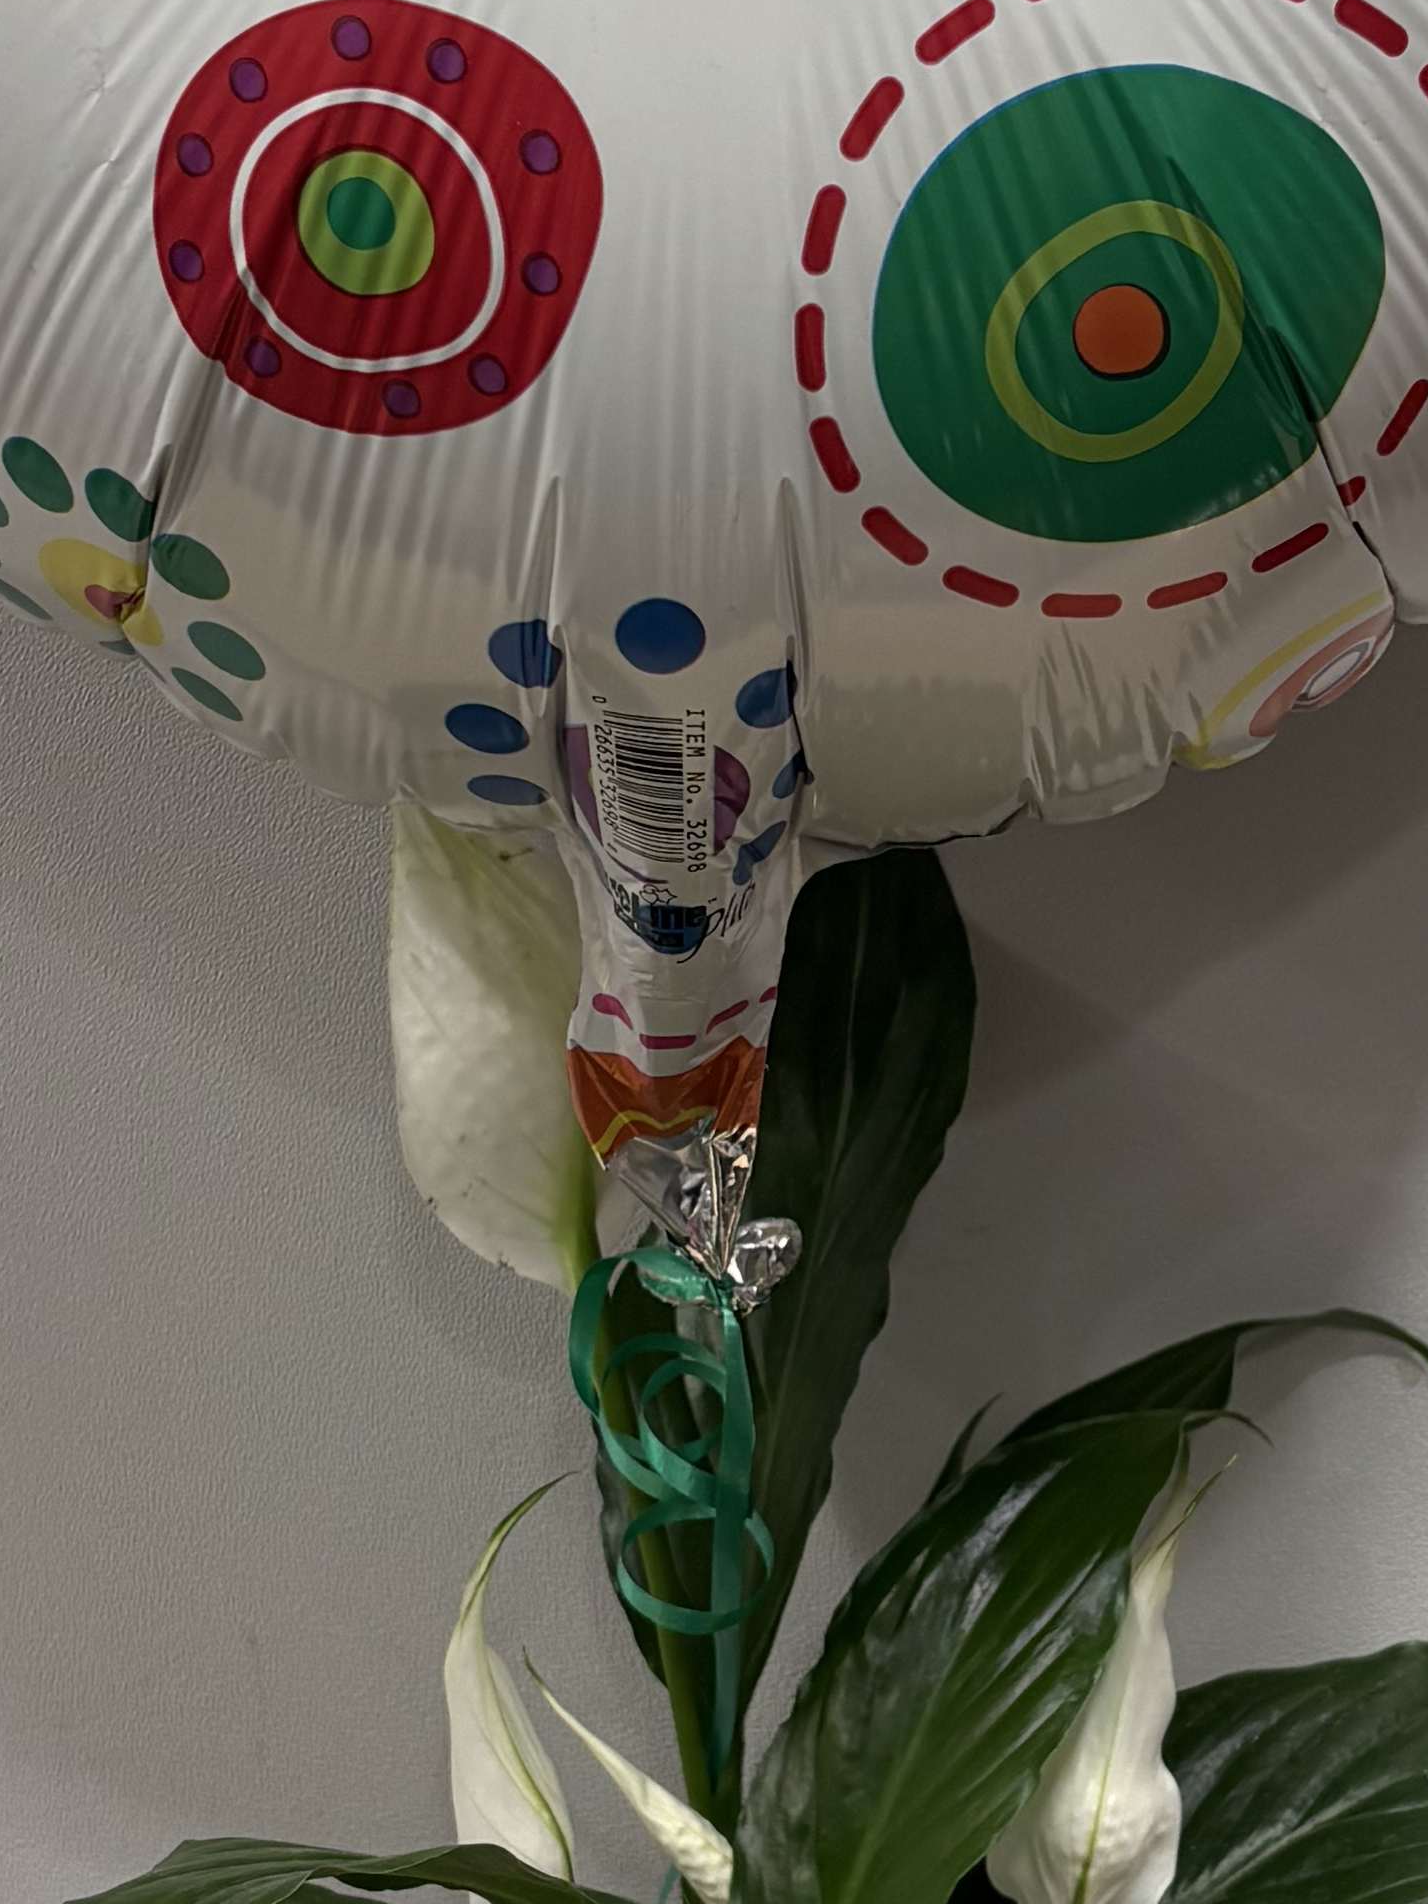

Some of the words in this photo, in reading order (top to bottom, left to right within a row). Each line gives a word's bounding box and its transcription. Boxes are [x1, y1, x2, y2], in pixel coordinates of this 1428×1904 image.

[594, 724, 616, 778] 26635
[686, 709, 706, 758] ITEM
[686, 772, 706, 805] No.
[686, 819, 707, 873] 32698
